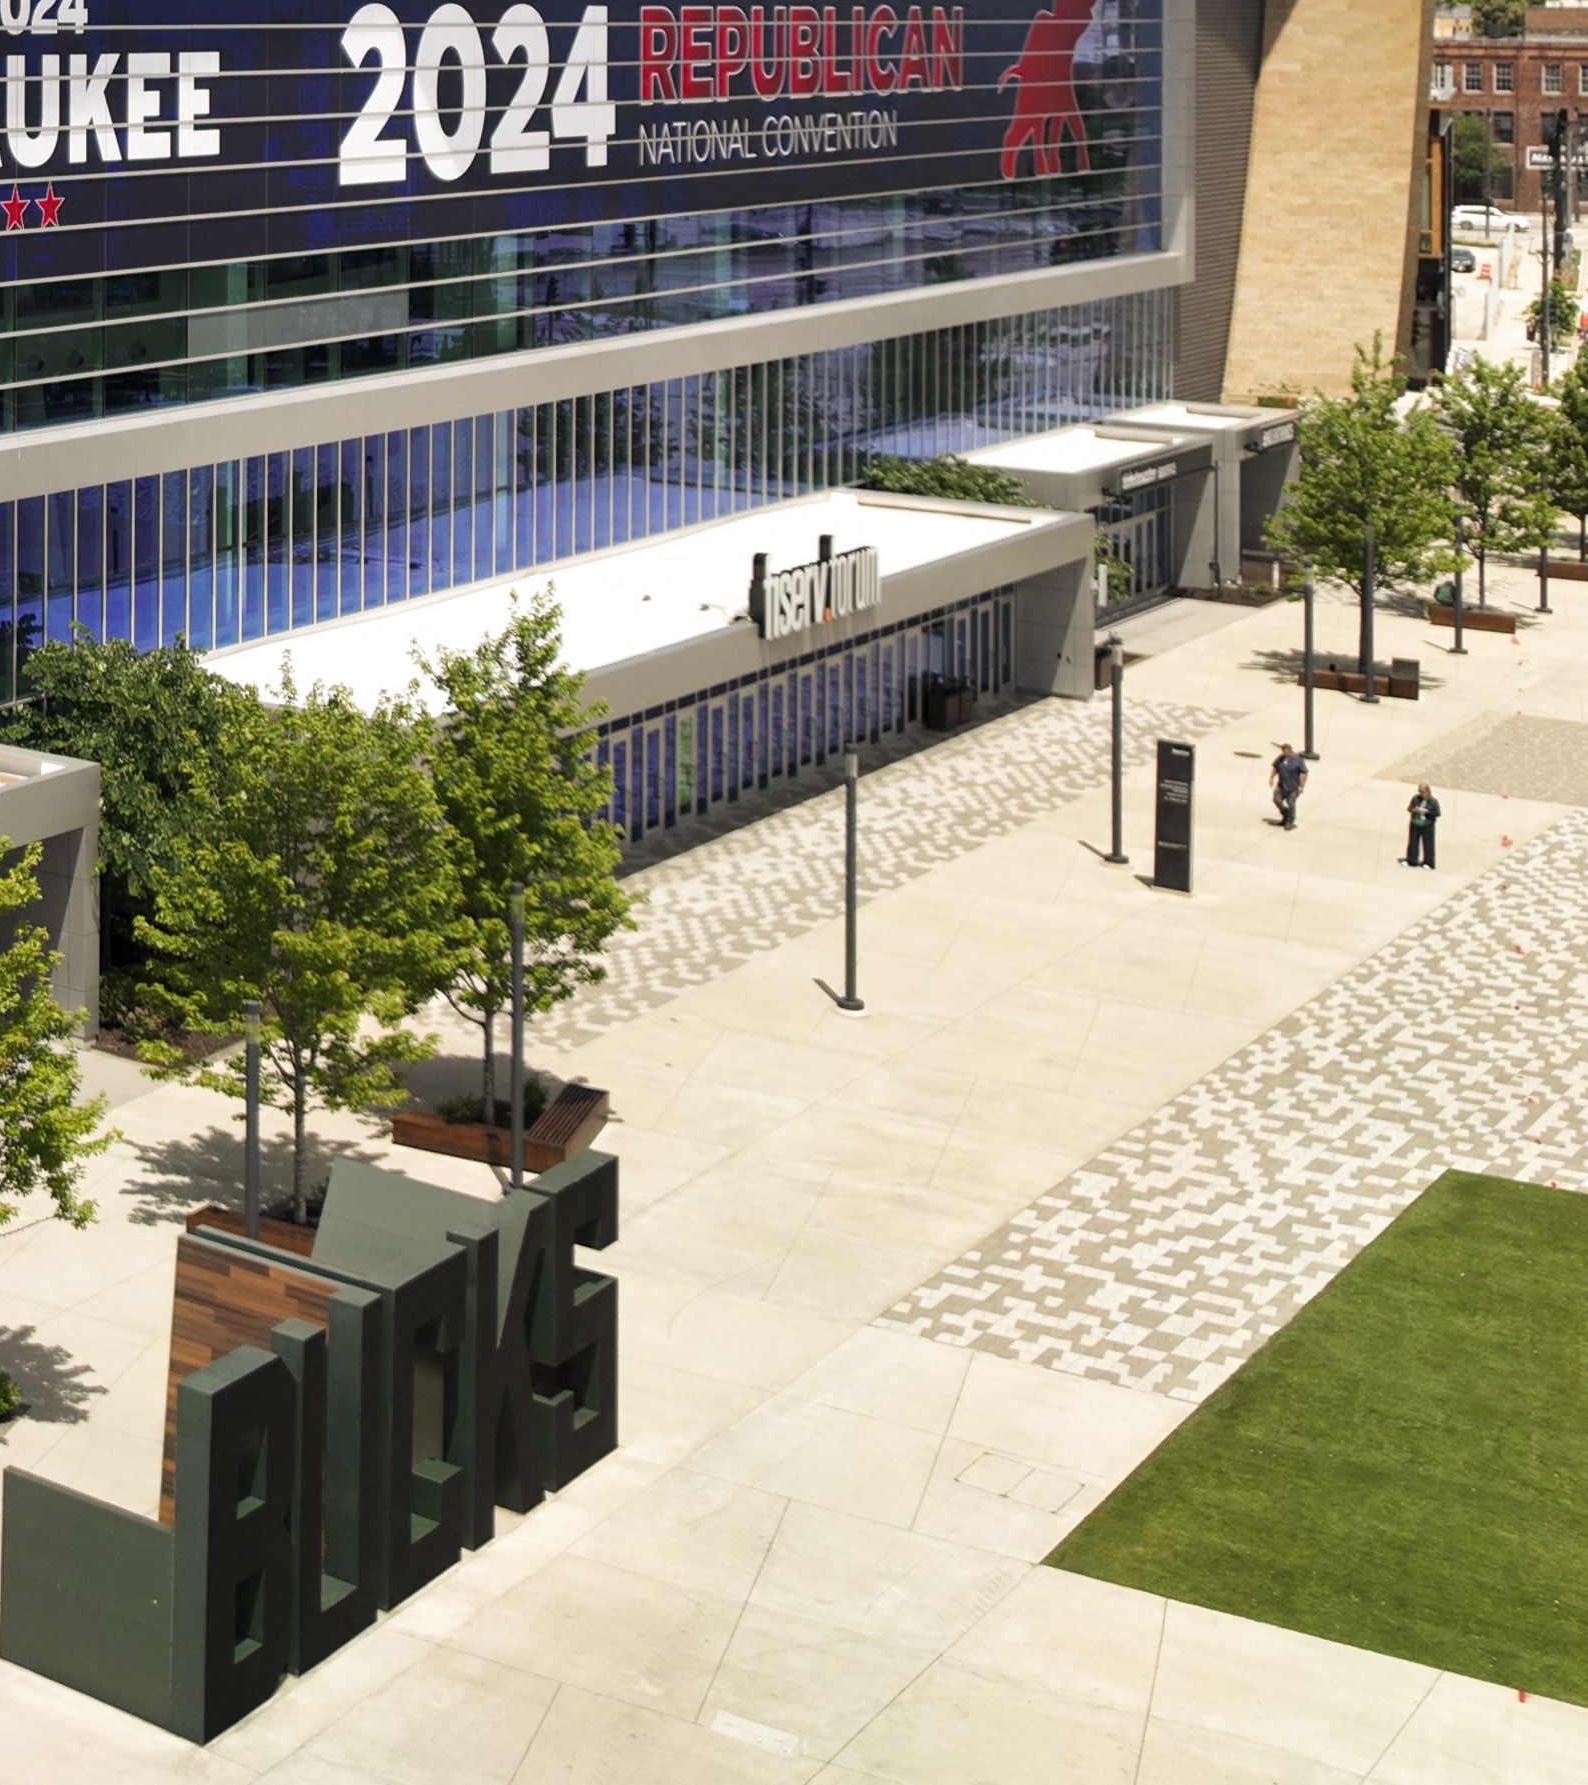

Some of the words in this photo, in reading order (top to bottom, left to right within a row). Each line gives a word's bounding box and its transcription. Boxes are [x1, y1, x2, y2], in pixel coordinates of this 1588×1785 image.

[337, 2, 616, 187] 2024
[638, 4, 964, 105] REPUBLICAN
[637, 120, 758, 167] NATIONAL
[761, 110, 898, 158] CONVENTION
[177, 1150, 620, 1744] BUCKS
